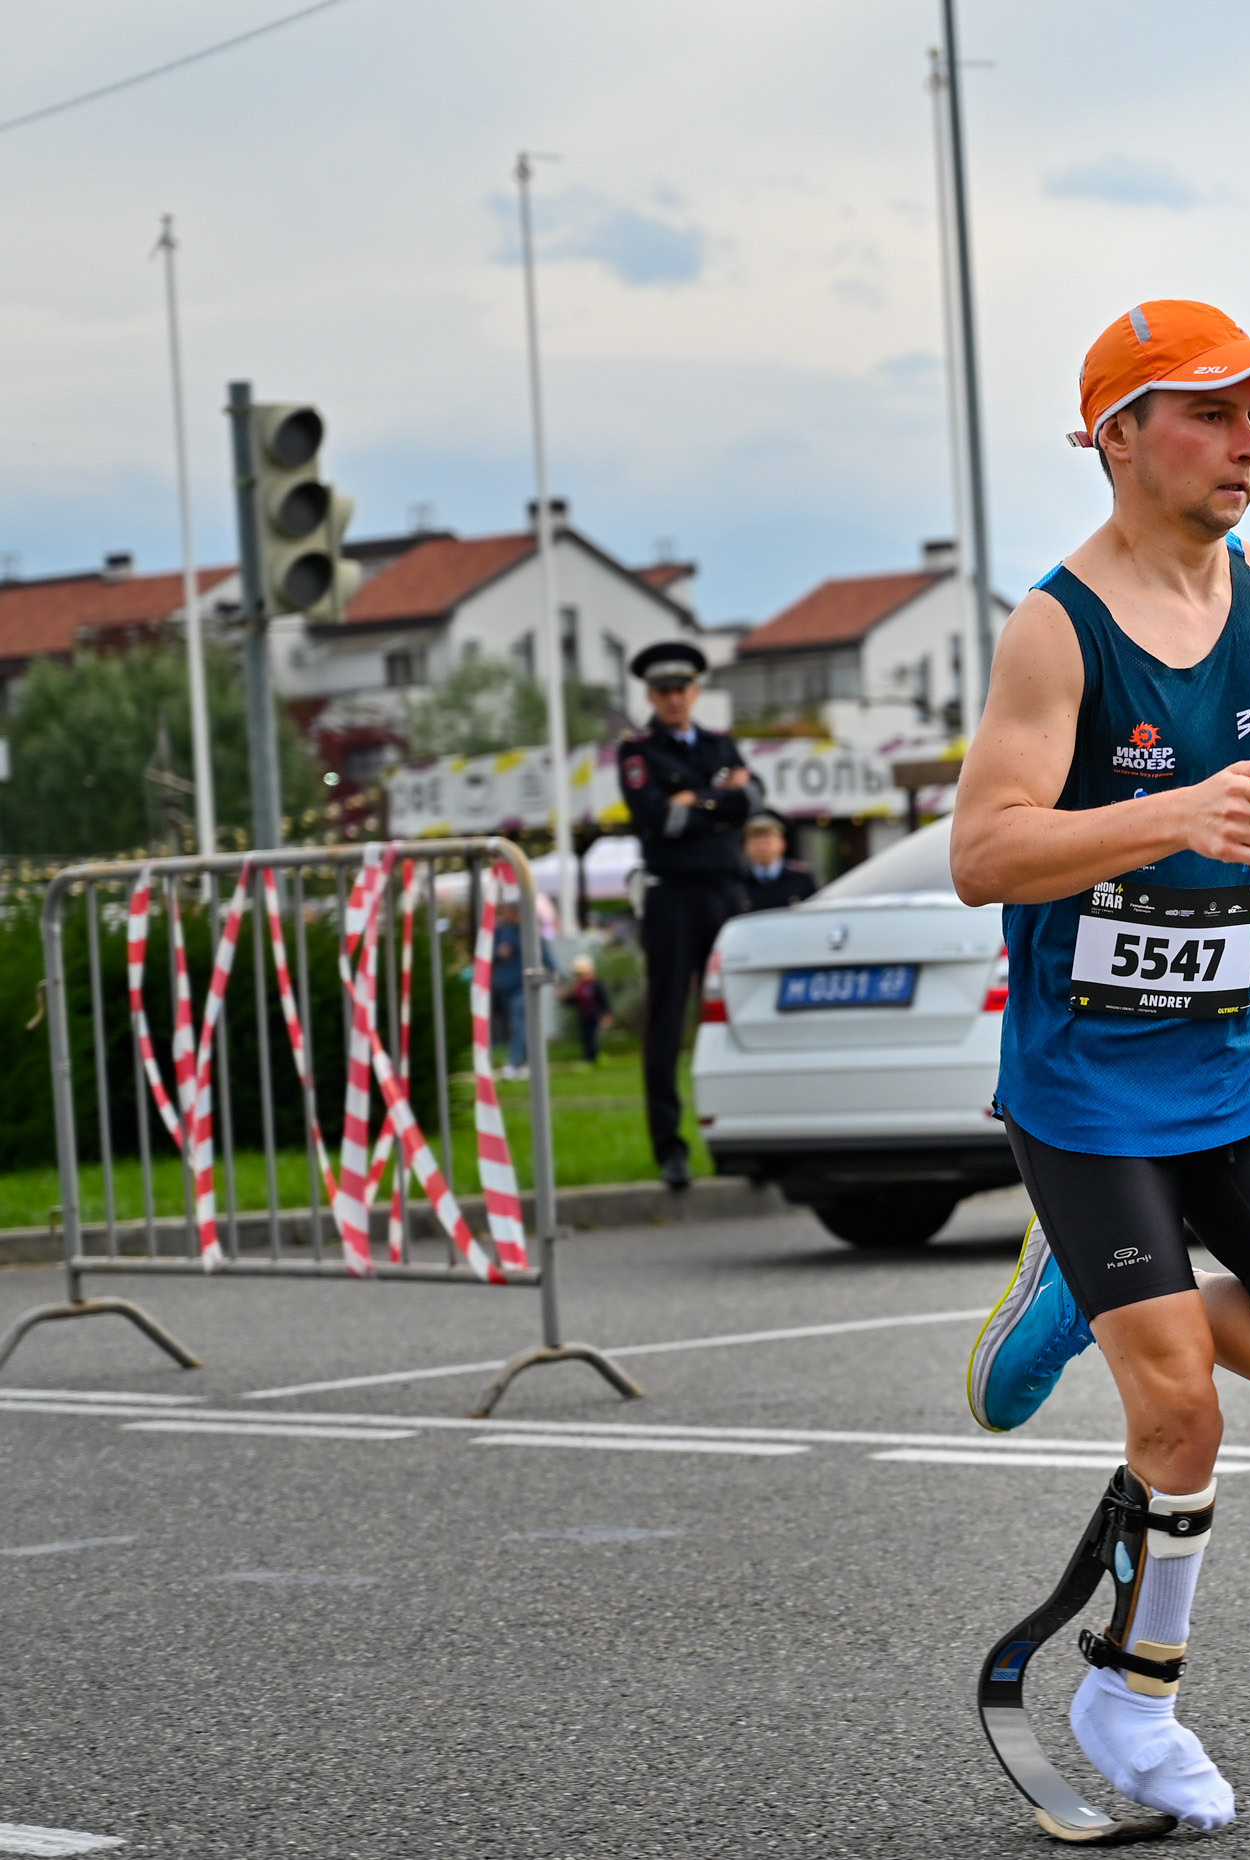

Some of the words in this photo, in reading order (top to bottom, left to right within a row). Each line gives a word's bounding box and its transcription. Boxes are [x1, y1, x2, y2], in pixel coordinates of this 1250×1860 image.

[1193, 366, 1228, 375] 2XU
[1116, 746, 1174, 759] ИНТЕР
[1094, 881, 1115, 893] IRON
[1092, 892, 1123, 910] STAR
[1111, 932, 1226, 981] 5547
[1139, 994, 1191, 1008] ANDREY
[1217, 1006, 1239, 1014] OLYMPIC
